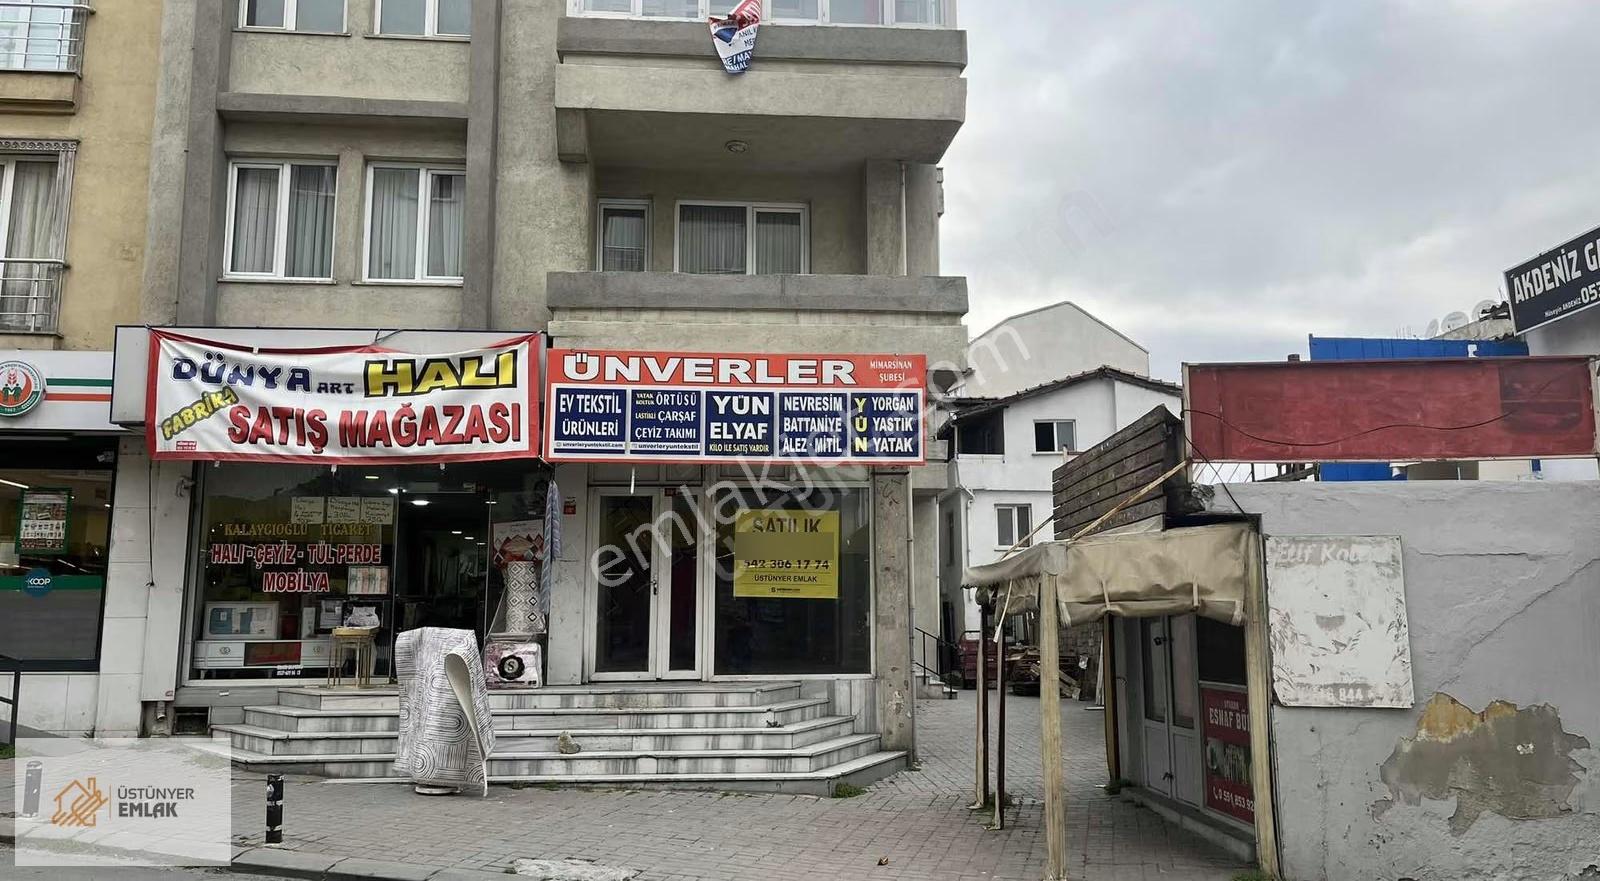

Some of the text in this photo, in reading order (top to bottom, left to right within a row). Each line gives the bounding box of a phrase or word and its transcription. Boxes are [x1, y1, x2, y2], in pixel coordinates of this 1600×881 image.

[1513, 248, 1581, 304] AKDENİZ
[563, 352, 857, 384] ÜNVERLER
[870, 359, 912, 369] MİMARSİNAN
[172, 350, 518, 398] DÜNYA ART HALI
[879, 372, 905, 382] ŞUBESİ
[560, 392, 622, 414] EV TEKSTİL
[656, 391, 697, 406] ÖRTÜSÜ
[713, 395, 769, 415] YÜN
[784, 394, 842, 411] NEVRESİM
[872, 396, 914, 412] YORGAN
[161, 385, 239, 440] FABRİKA
[658, 410, 697, 423] ÇARŞAF
[228, 402, 521, 454] SATIŞ MAĞAZASI
[562, 418, 618, 436] ÜRÜNLERİ
[635, 426, 696, 440] ÇEYİZ TAKIMI
[710, 422, 768, 440] ELYAF
[783, 415, 842, 433] BATTANİYE
[873, 417, 913, 432] YASTIK
[783, 435, 842, 453] ALEZ MİTİL
[873, 437, 913, 453] YATAK
[211, 540, 382, 569] HALI ÇEYİZ TÜL PERDE
[263, 568, 330, 593] MOBİLYA
[793, 575, 817, 583] EMLAK
[1209, 707, 1233, 728] ESNAF
